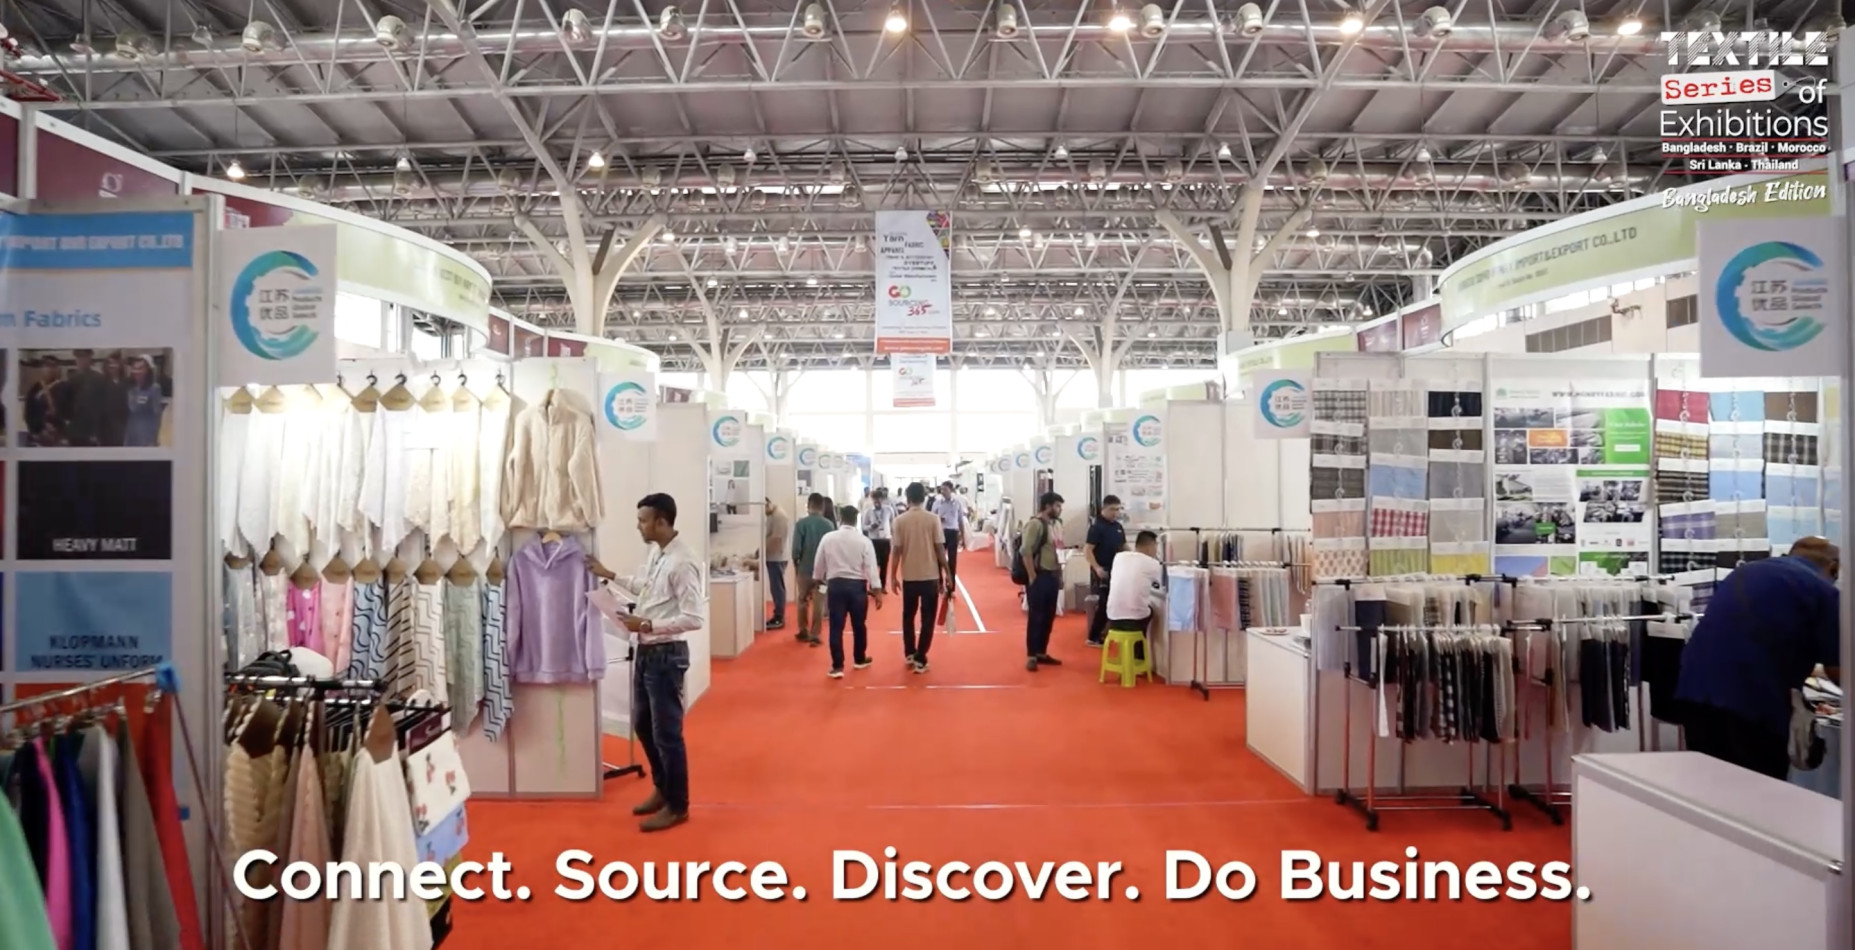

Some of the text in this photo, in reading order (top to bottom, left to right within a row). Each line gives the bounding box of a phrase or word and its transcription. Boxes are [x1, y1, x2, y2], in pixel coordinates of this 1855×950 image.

[883, 234, 904, 242] Yarn
[888, 285, 911, 299] GO
[1752, 280, 1787, 294] 江苏
[259, 288, 290, 303] 江苏
[1752, 297, 1788, 311] 优品
[24, 310, 101, 328] Fabrics
[260, 305, 289, 320] 优品
[52, 538, 136, 552] HEAVY MATT
